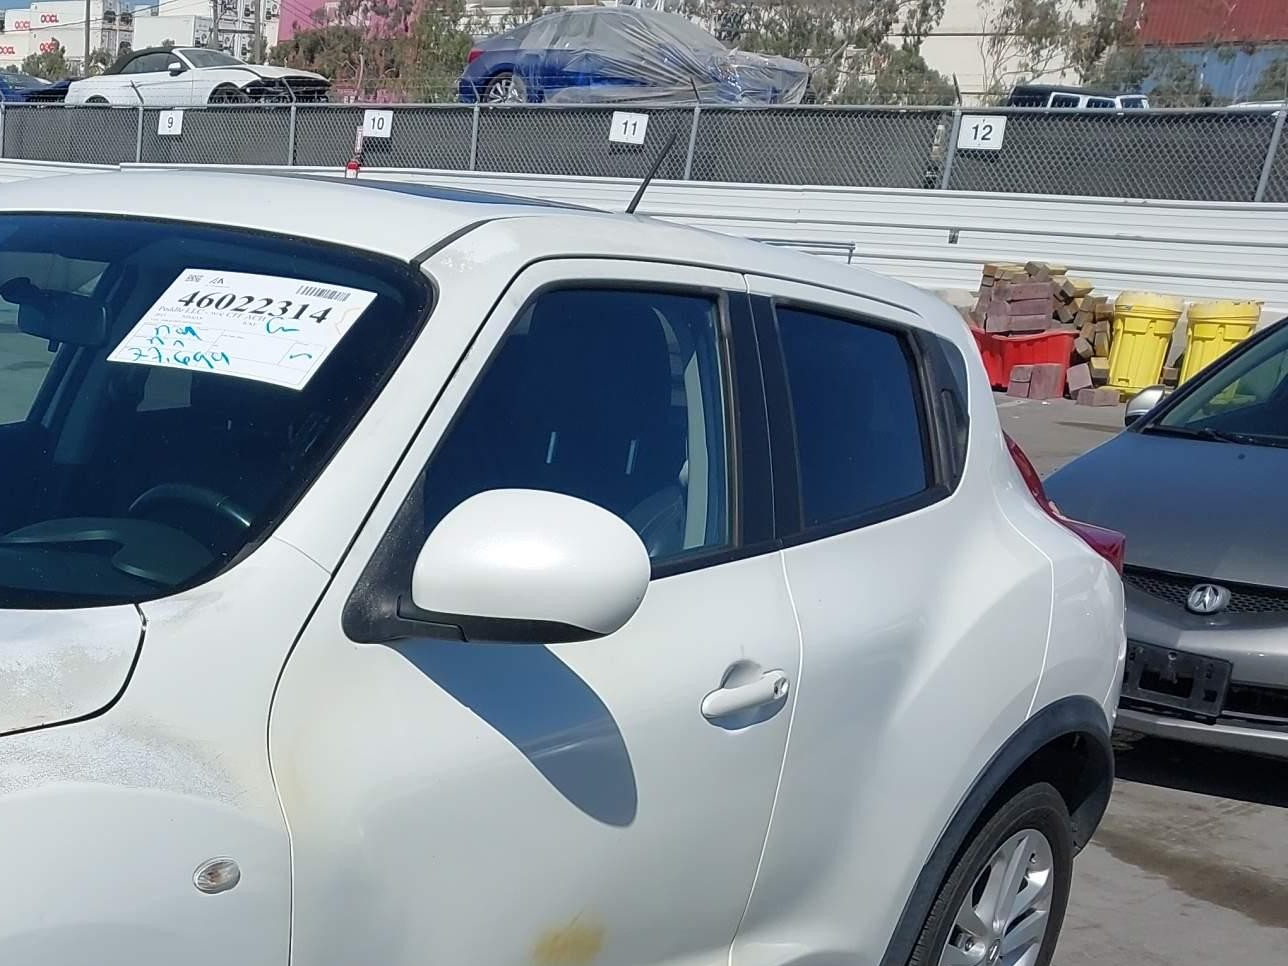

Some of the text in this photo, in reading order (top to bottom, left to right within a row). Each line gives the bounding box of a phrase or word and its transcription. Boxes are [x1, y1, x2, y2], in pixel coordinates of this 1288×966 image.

[41, 14, 59, 23] OOCL
[167, 116, 174, 129] 9
[371, 117, 384, 130] 10
[622, 120, 637, 136] 11
[972, 124, 993, 140] 12
[178, 291, 333, 323] 46022314
